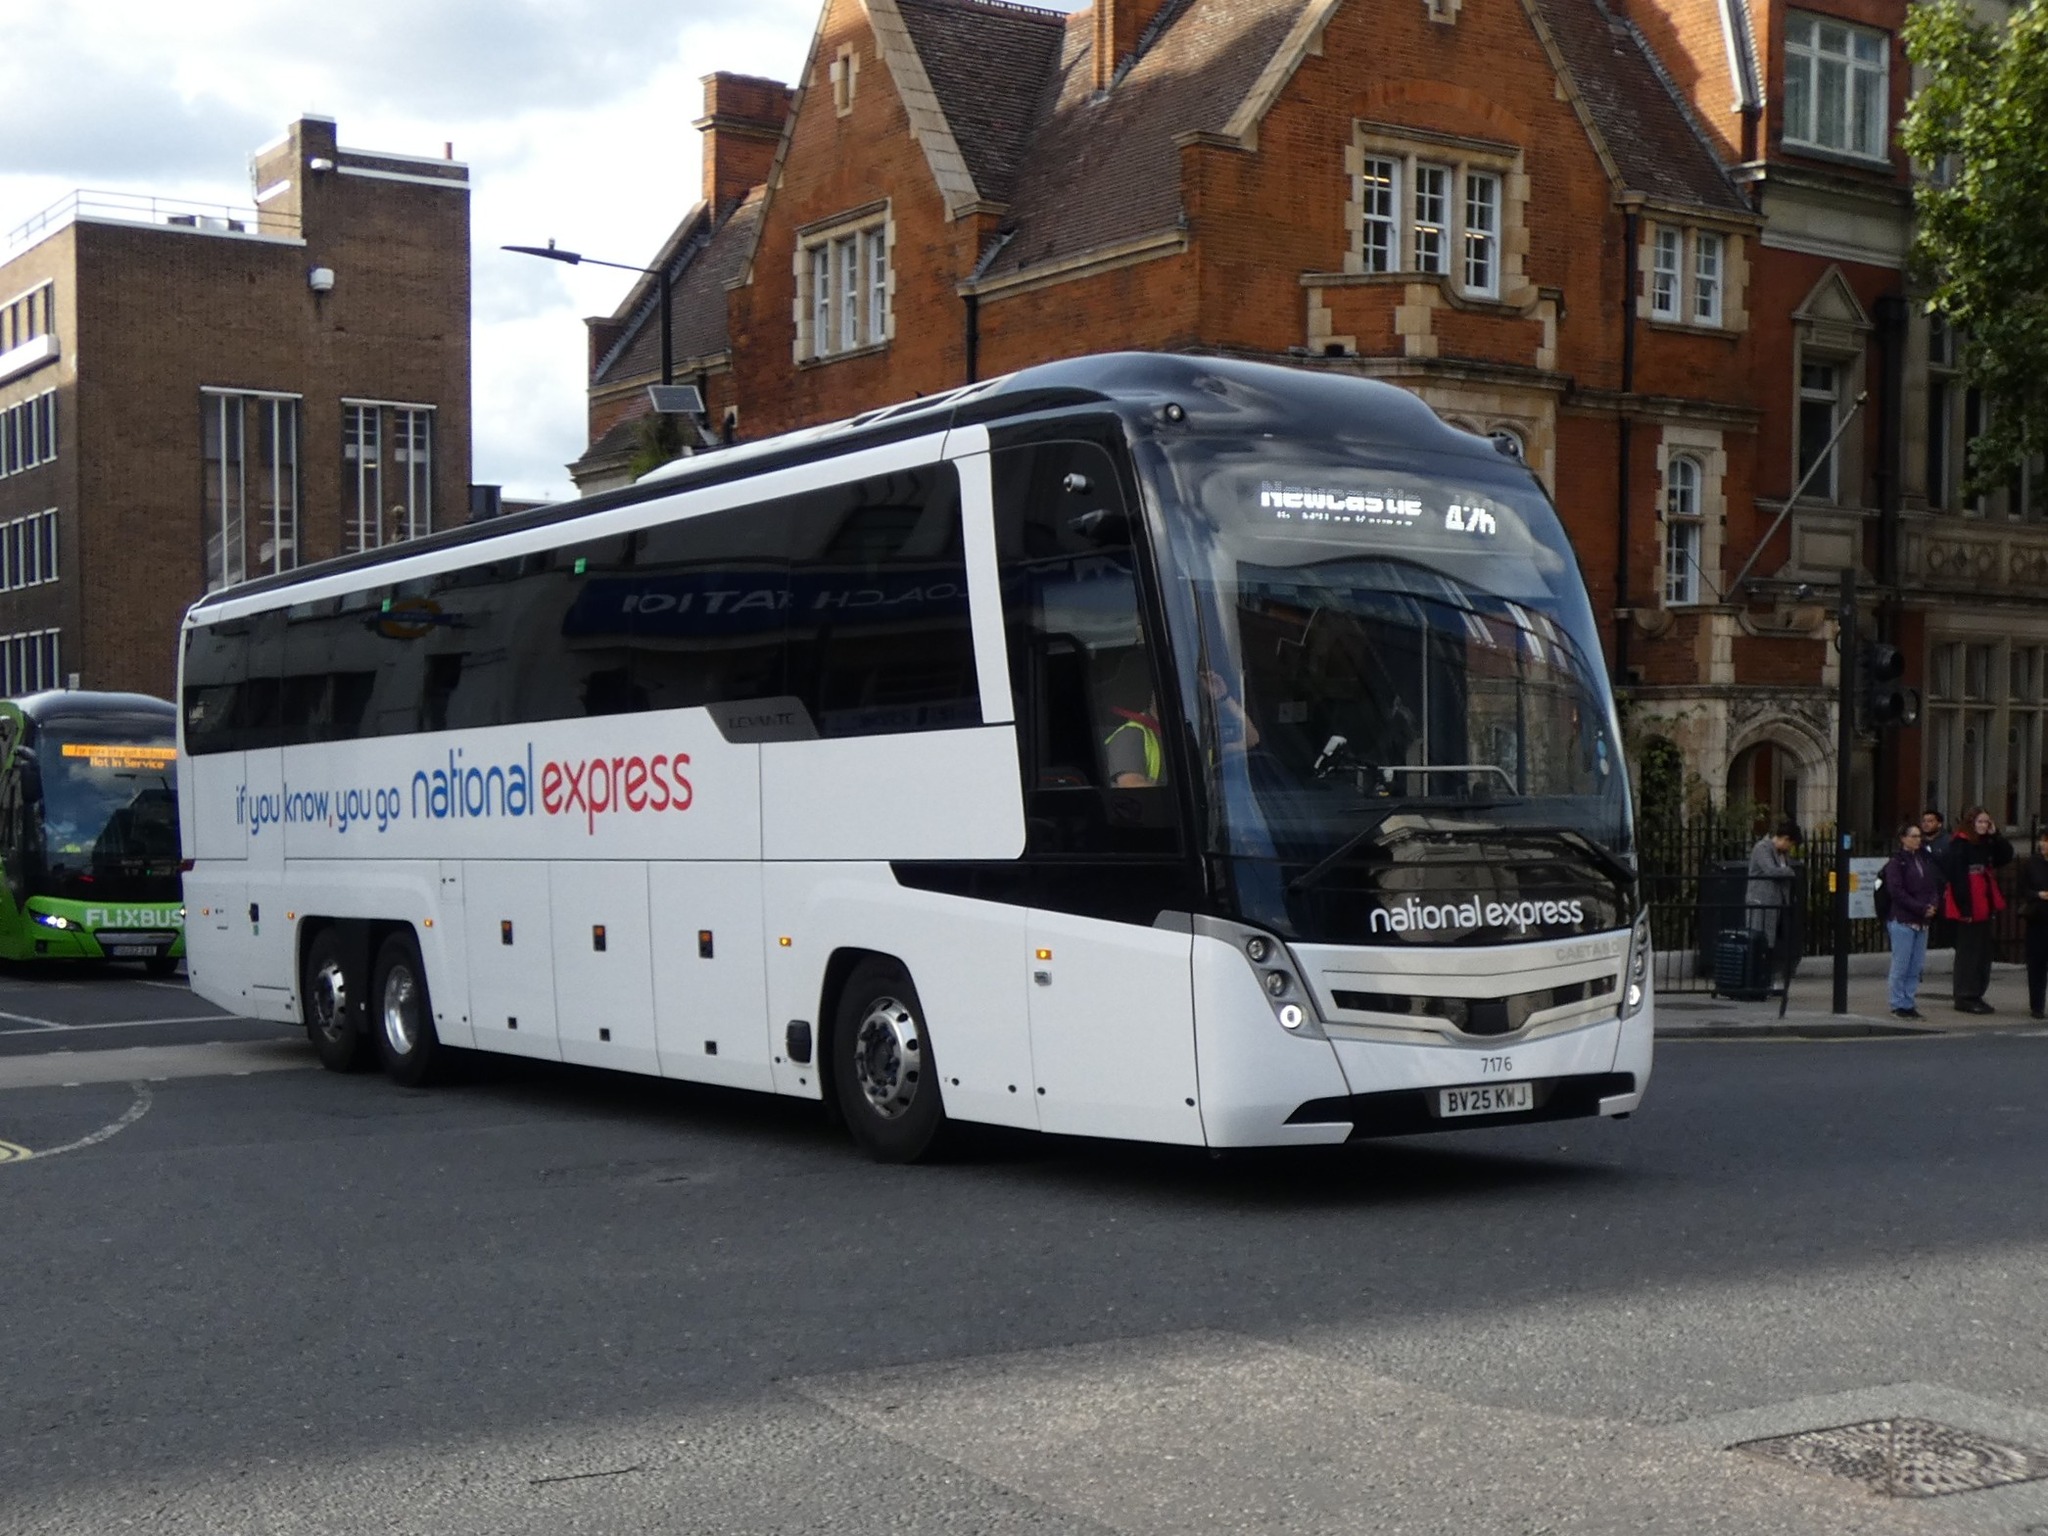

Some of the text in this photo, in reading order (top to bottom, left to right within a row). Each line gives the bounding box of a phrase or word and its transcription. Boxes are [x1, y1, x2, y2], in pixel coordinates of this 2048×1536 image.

[236, 742, 693, 836] if you know, you go national express
[1370, 894, 1584, 934] national express
[1481, 1056, 1513, 1074] 7176
[1448, 1084, 1527, 1113] BV25 KWJ
